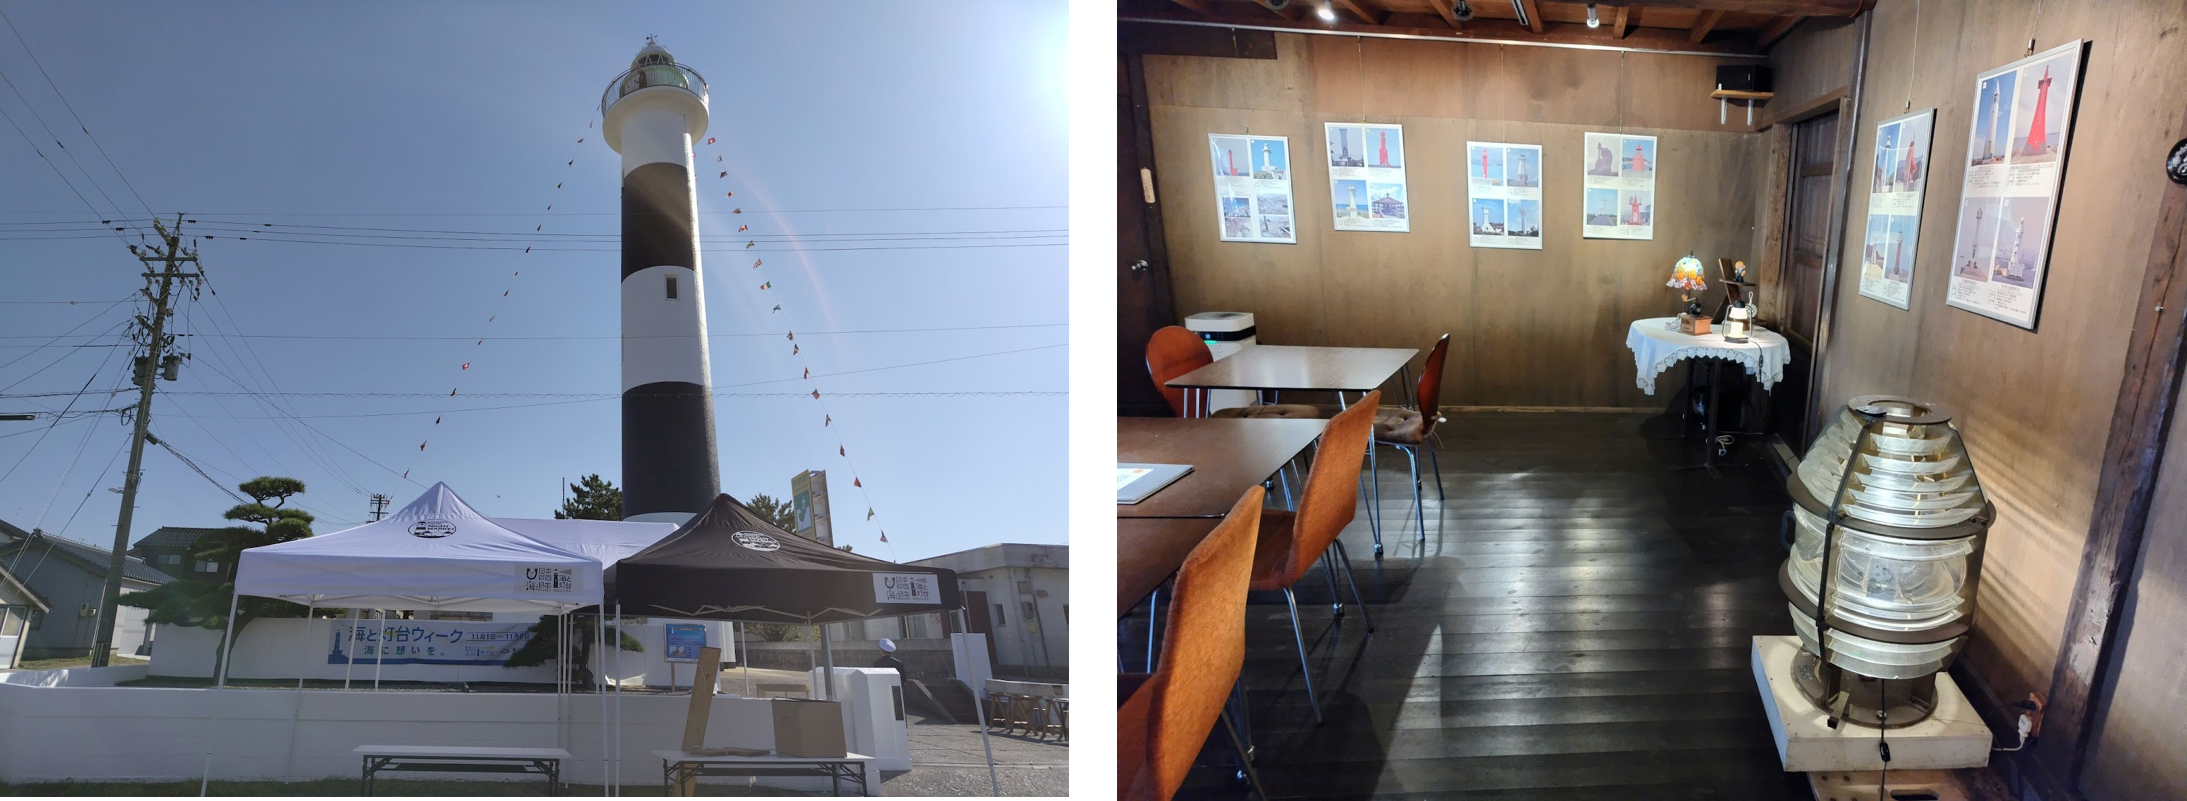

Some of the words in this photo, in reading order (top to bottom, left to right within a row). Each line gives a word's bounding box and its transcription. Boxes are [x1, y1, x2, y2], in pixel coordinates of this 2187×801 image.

[348, 625, 463, 643] 海と灯台ウィーク
